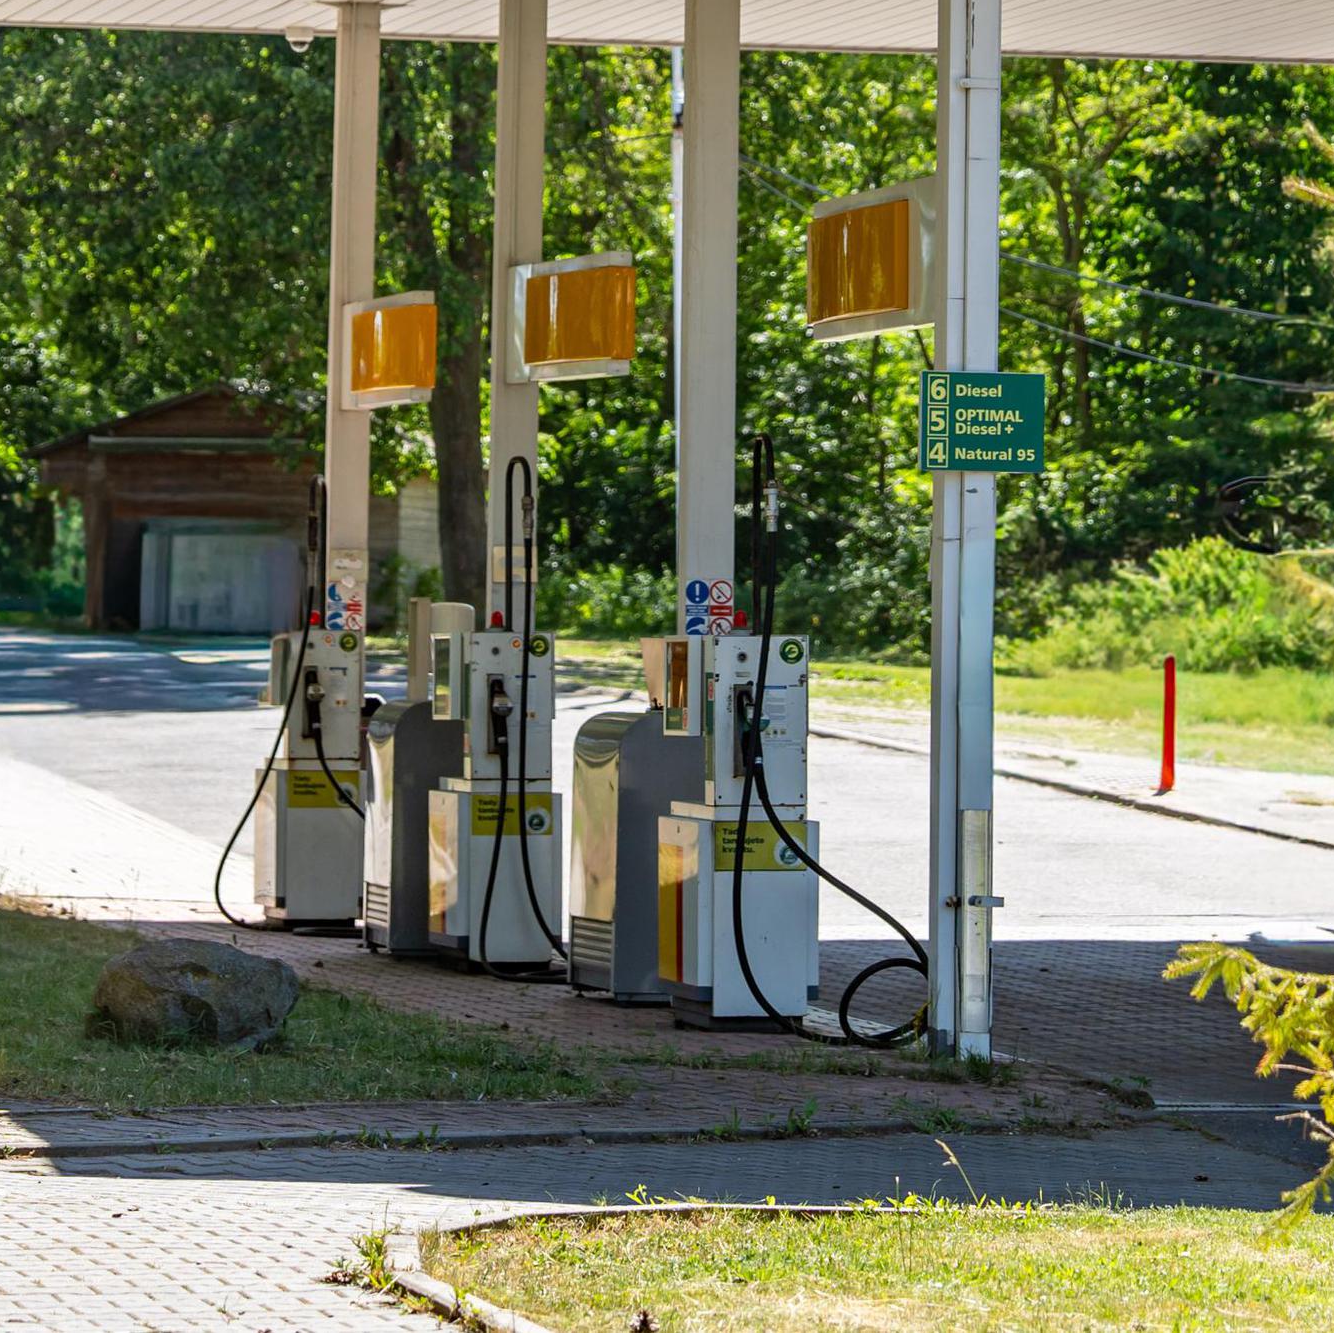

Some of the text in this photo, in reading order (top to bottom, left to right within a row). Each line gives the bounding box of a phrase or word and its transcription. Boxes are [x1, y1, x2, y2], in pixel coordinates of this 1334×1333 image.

[930, 378, 1003, 400] 6 Diesel
[930, 408, 1024, 431] 5 OPTIMAL
[955, 422, 1002, 435] Diesel
[929, 442, 1036, 463] 4 Natural 95
